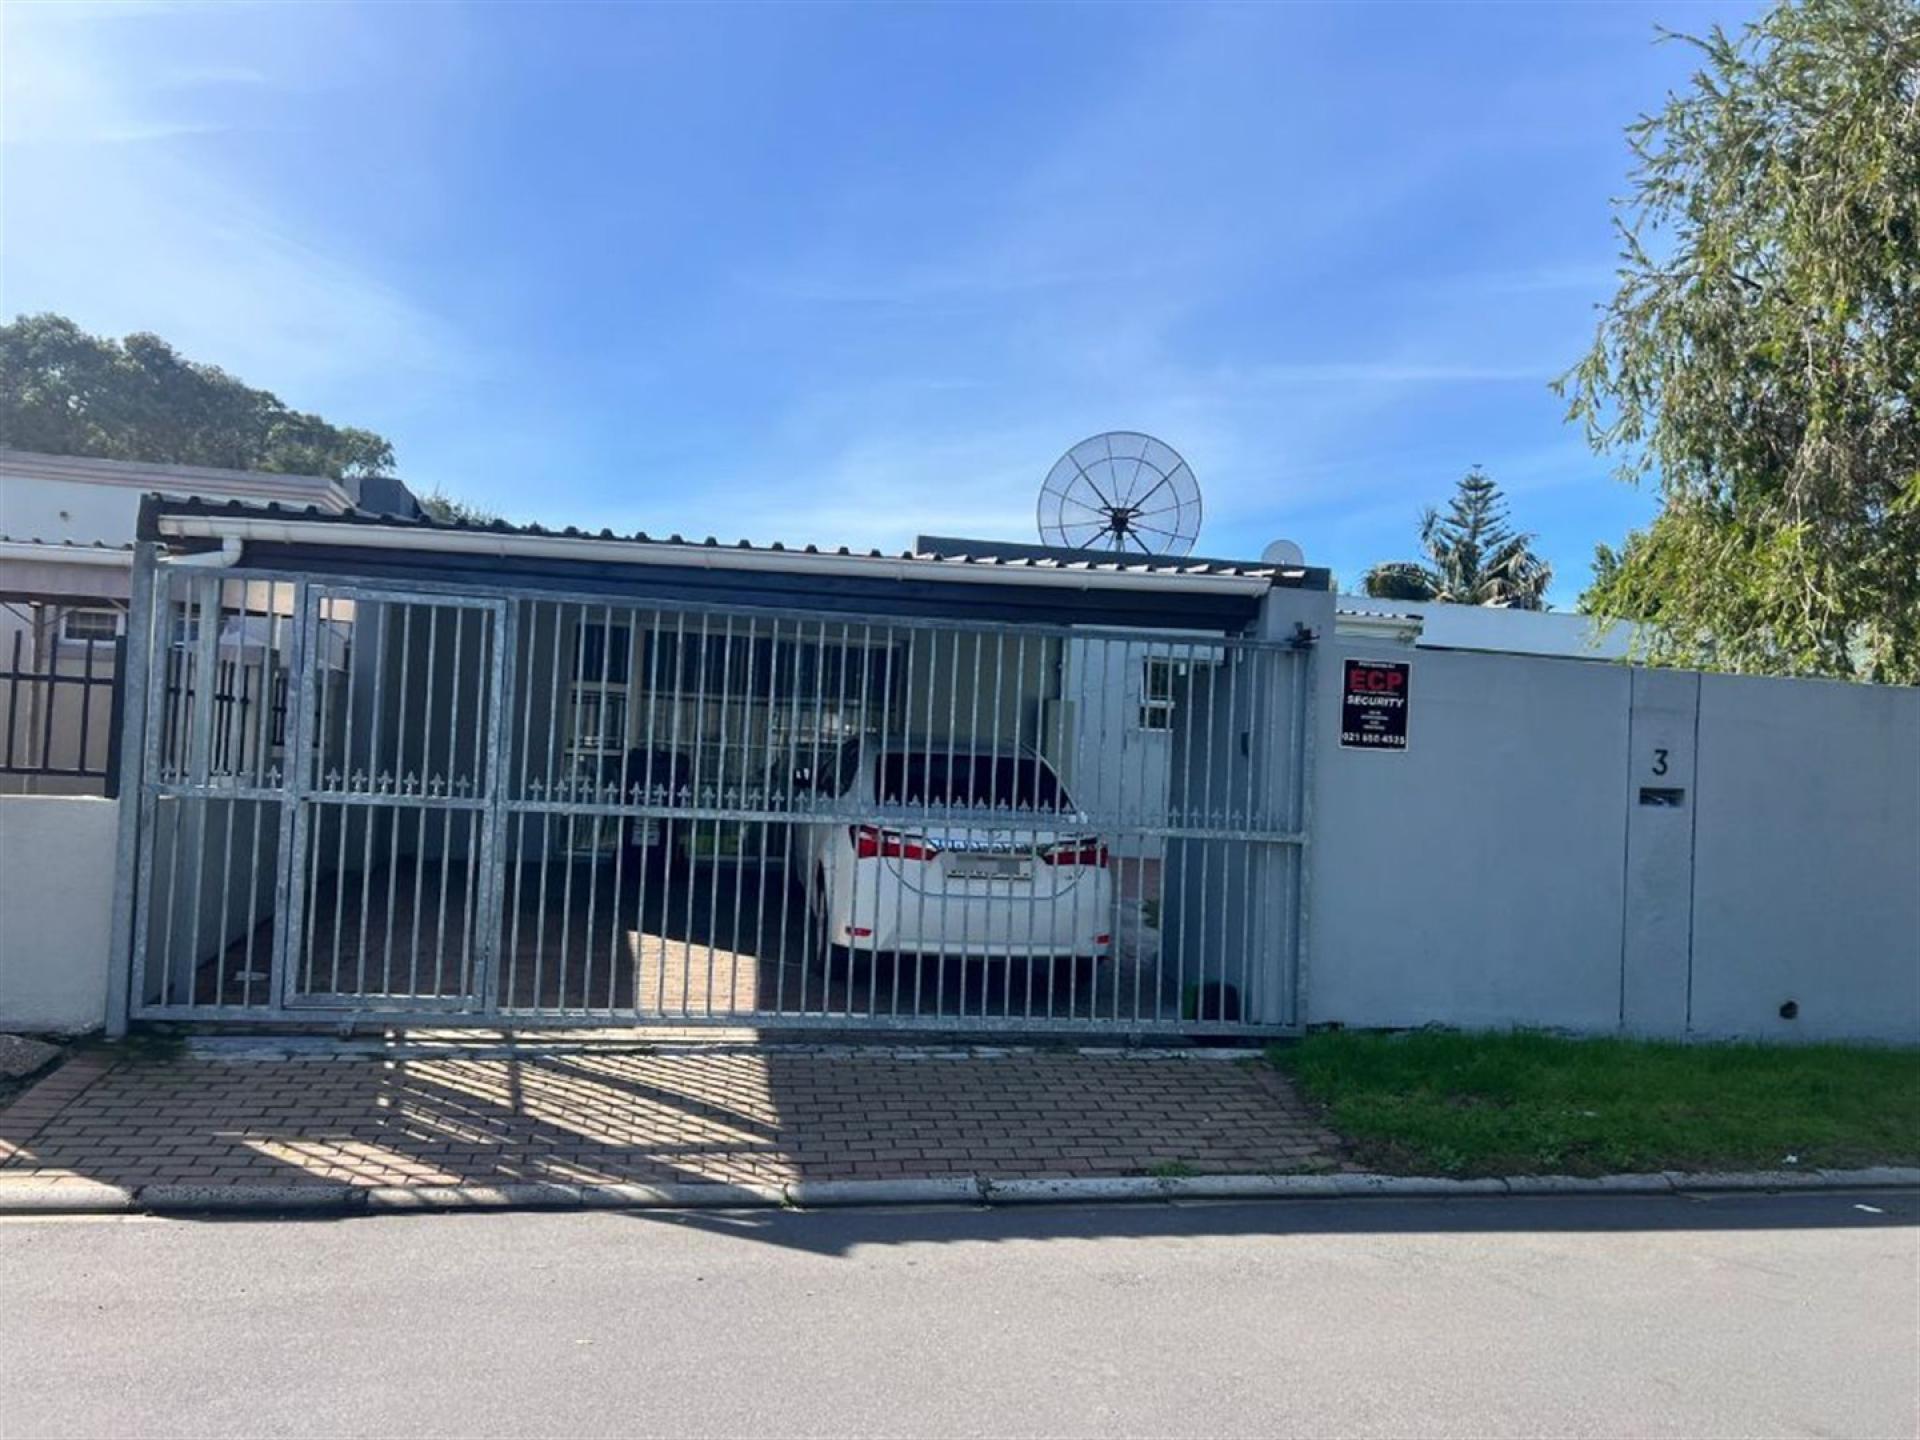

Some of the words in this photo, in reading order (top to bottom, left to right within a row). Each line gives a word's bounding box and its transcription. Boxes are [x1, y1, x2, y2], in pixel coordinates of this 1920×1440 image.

[1350, 669, 1402, 690] ECP
[1347, 695, 1404, 708] SECURITY
[1652, 749, 1668, 776] 3
